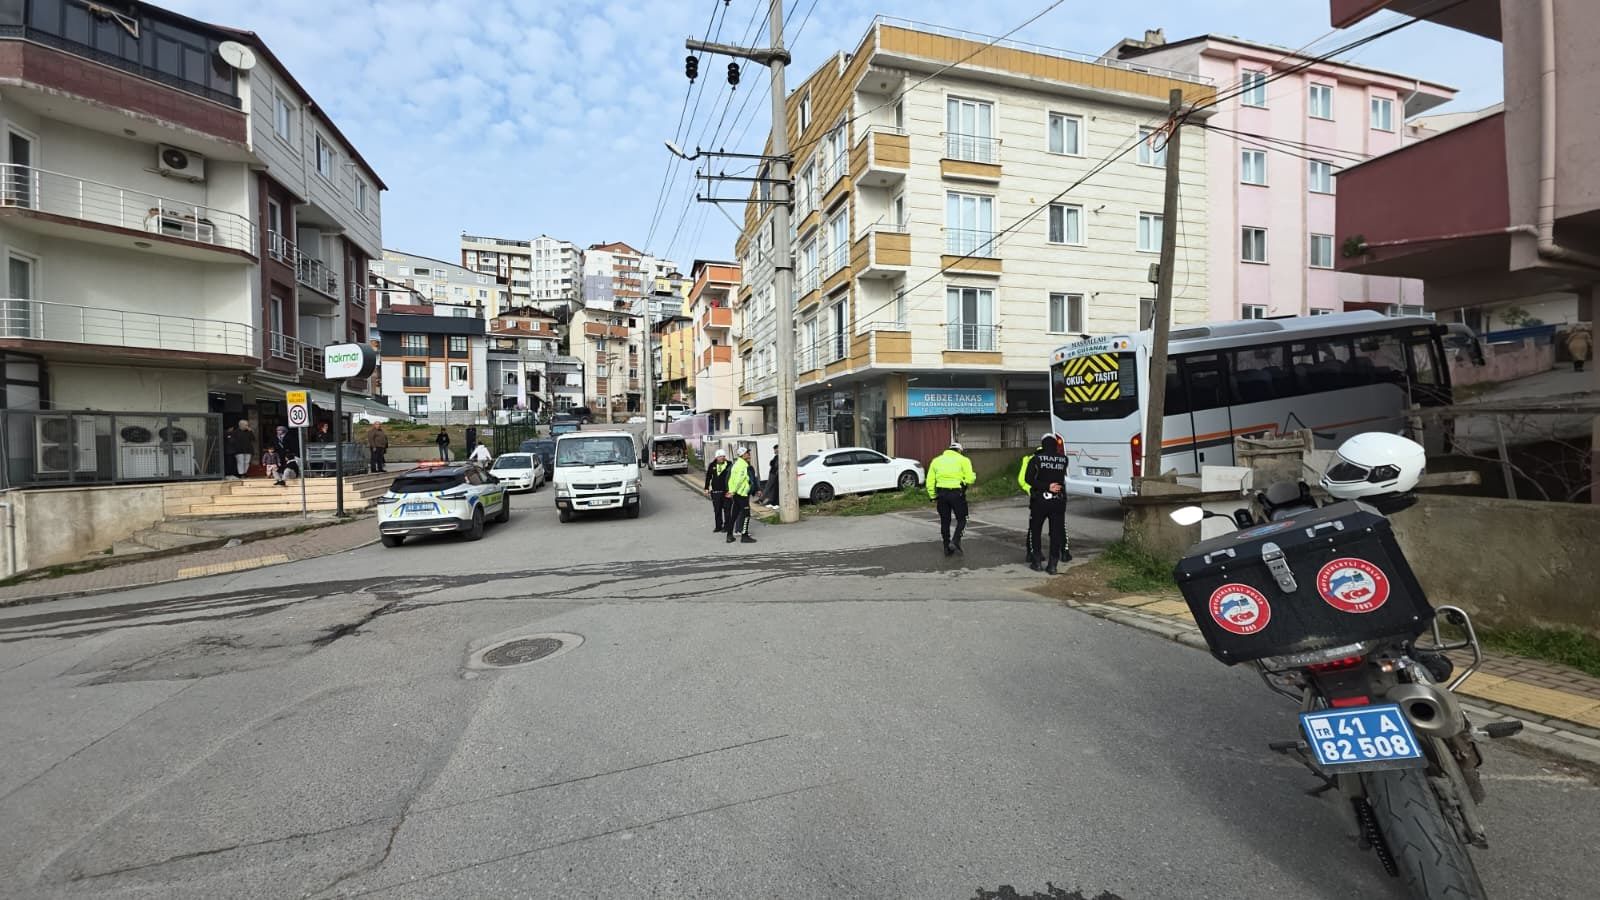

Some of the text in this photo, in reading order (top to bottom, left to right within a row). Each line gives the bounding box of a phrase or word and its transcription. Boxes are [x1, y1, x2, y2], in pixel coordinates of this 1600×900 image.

[328, 353, 359, 363] hakmar
[1066, 371, 1118, 385] OKUL TAŞITI
[293, 410, 303, 420] 30
[1315, 714, 1400, 737] TR 41 A
[1321, 734, 1411, 761] 82 508
